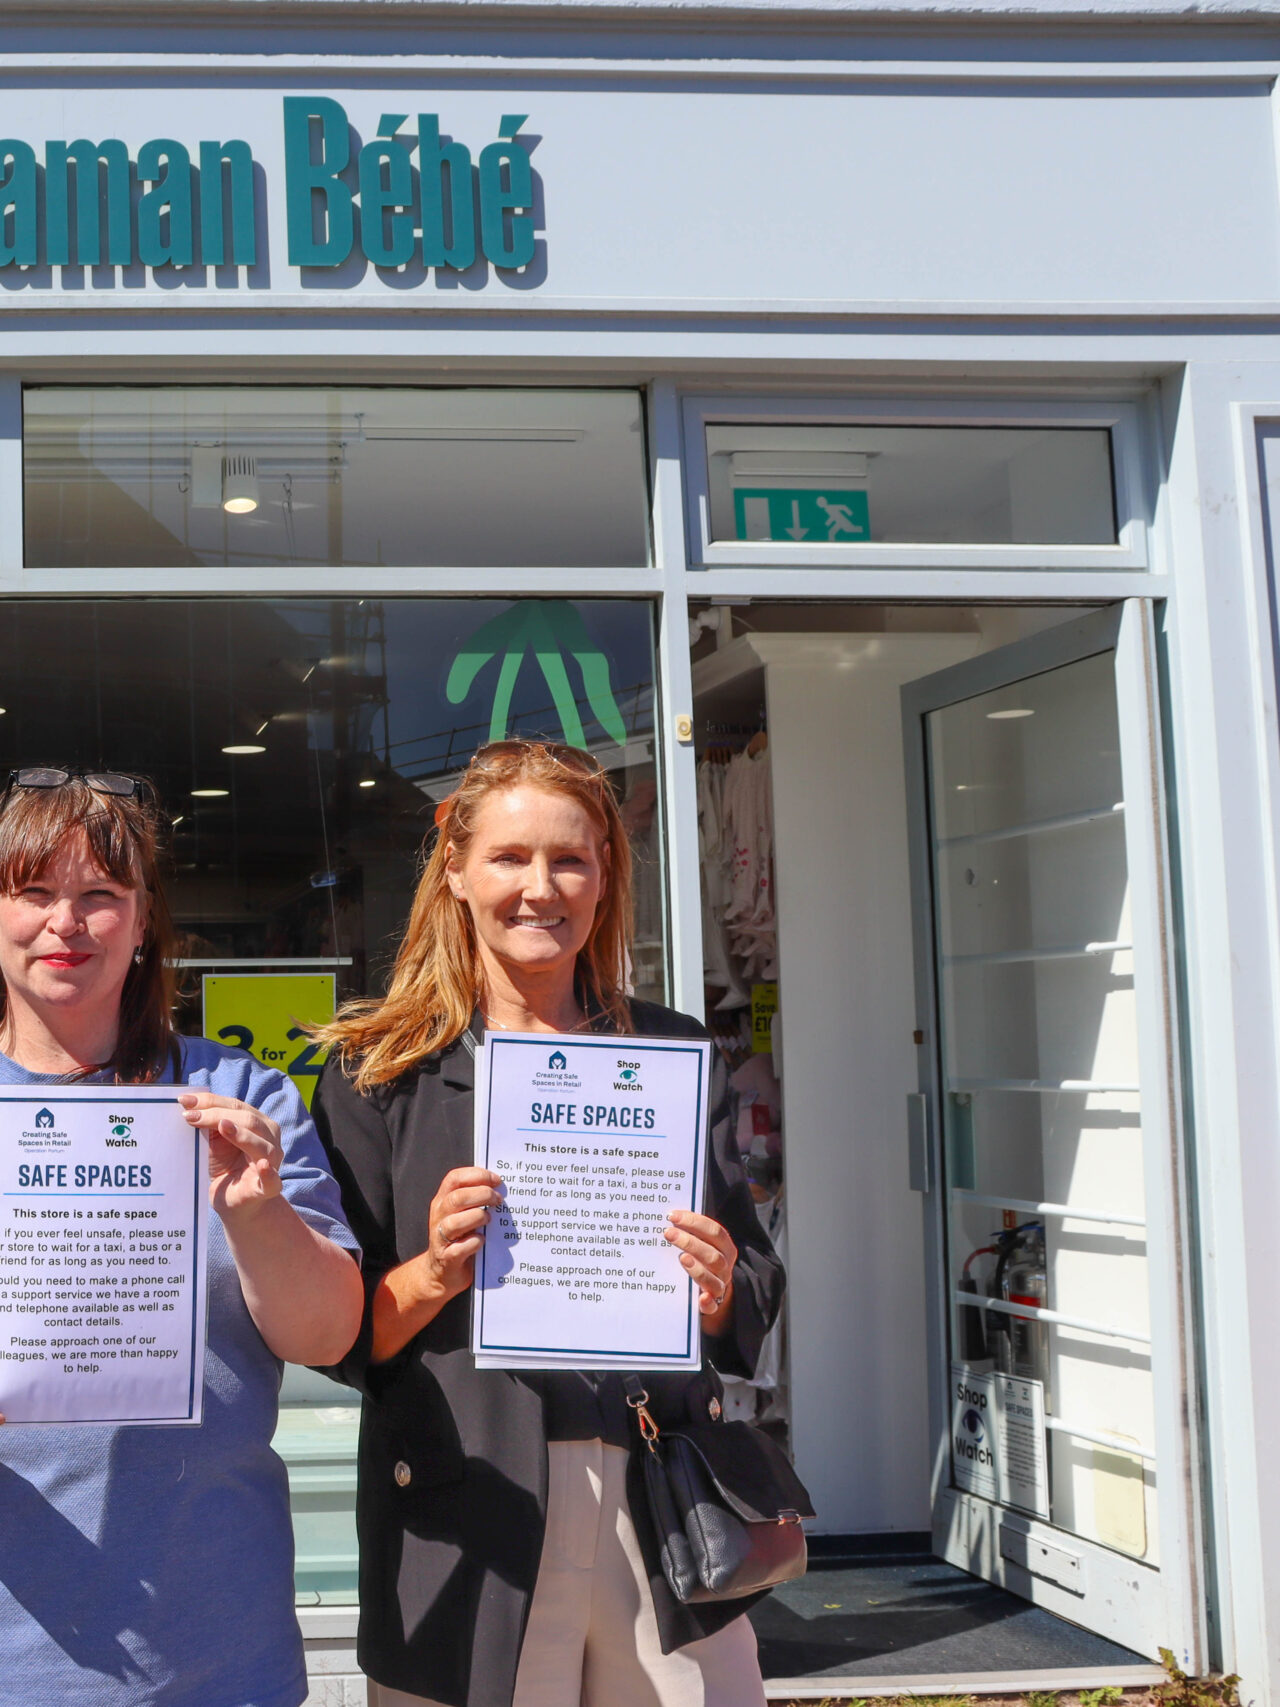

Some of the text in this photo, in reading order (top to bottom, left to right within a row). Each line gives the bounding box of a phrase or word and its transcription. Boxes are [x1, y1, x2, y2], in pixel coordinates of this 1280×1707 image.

[283, 96, 535, 269] Bébé
[261, 1048, 287, 1060] for
[617, 1060, 641, 1071] Shop
[536, 1072, 563, 1080] Creating
[532, 1079, 555, 1087] Spaces
[613, 1082, 643, 1092] Watch
[108, 1115, 134, 1125] Shop
[531, 1102, 655, 1129] SAFE SPACES
[22, 1131, 51, 1139] Creating
[18, 1139, 43, 1147] Spaces
[105, 1137, 137, 1148] Watch
[524, 1143, 659, 1159] This store is a safe space
[18, 1164, 151, 1188] SAFE SPACES
[13, 1208, 157, 1221] This store is a safe space
[4, 1228, 11, 1238] if
[14, 1230, 33, 1241] you
[36, 1230, 60, 1238] ever
[63, 1228, 83, 1239] feel
[86, 1228, 125, 1240] unsafe,
[129, 1229, 164, 1241] please
[167, 1230, 186, 1238] use
[8, 1242, 34, 1252] store
[38, 1243, 48, 1252] to
[51, 1243, 73, 1252] wait
[76, 1242, 91, 1252] for
[93, 1244, 100, 1252] a
[103, 1242, 125, 1253] taxi,
[129, 1244, 136, 1252] a
[139, 1242, 158, 1252] bus
[161, 1243, 172, 1252] or
[175, 1243, 182, 1251] a
[550, 1247, 624, 1258] contact details.
[30, 1256, 45, 1266] for
[48, 1258, 61, 1266] as
[64, 1256, 87, 1268] long
[90, 1258, 103, 1266] as
[106, 1258, 125, 1268] you
[129, 1255, 155, 1266] need
[158, 1256, 171, 1265] to.
[23, 1278, 42, 1288] you
[46, 1276, 72, 1286] need
[76, 1276, 86, 1286] to
[89, 1275, 118, 1286] make
[121, 1277, 128, 1285] a
[131, 1275, 164, 1287] phone
[167, 1274, 185, 1284] call
[498, 1275, 676, 1294] colleagues, we are more than happy
[1, 1291, 8, 1299] a
[11, 1290, 52, 1301] support
[55, 1289, 93, 1300] service
[95, 1291, 111, 1299] we
[114, 1289, 140, 1299] have
[143, 1290, 150, 1299] a
[153, 1290, 180, 1298] room
[568, 1291, 604, 1304] to help.
[16, 1303, 69, 1315] telephone
[72, 1303, 119, 1313] available
[122, 1304, 135, 1312] as
[138, 1302, 159, 1312] well
[162, 1303, 174, 1312] as
[44, 1316, 123, 1327] contact details.
[10, 1335, 156, 1348] Please approach one of our
[51, 1352, 66, 1360] we
[69, 1352, 87, 1360] are
[90, 1351, 117, 1359] more
[120, 1349, 143, 1359] than
[146, 1348, 178, 1359] happy
[63, 1363, 102, 1374] to help.
[957, 1383, 988, 1409] Shop
[955, 1436, 994, 1467] Watch
